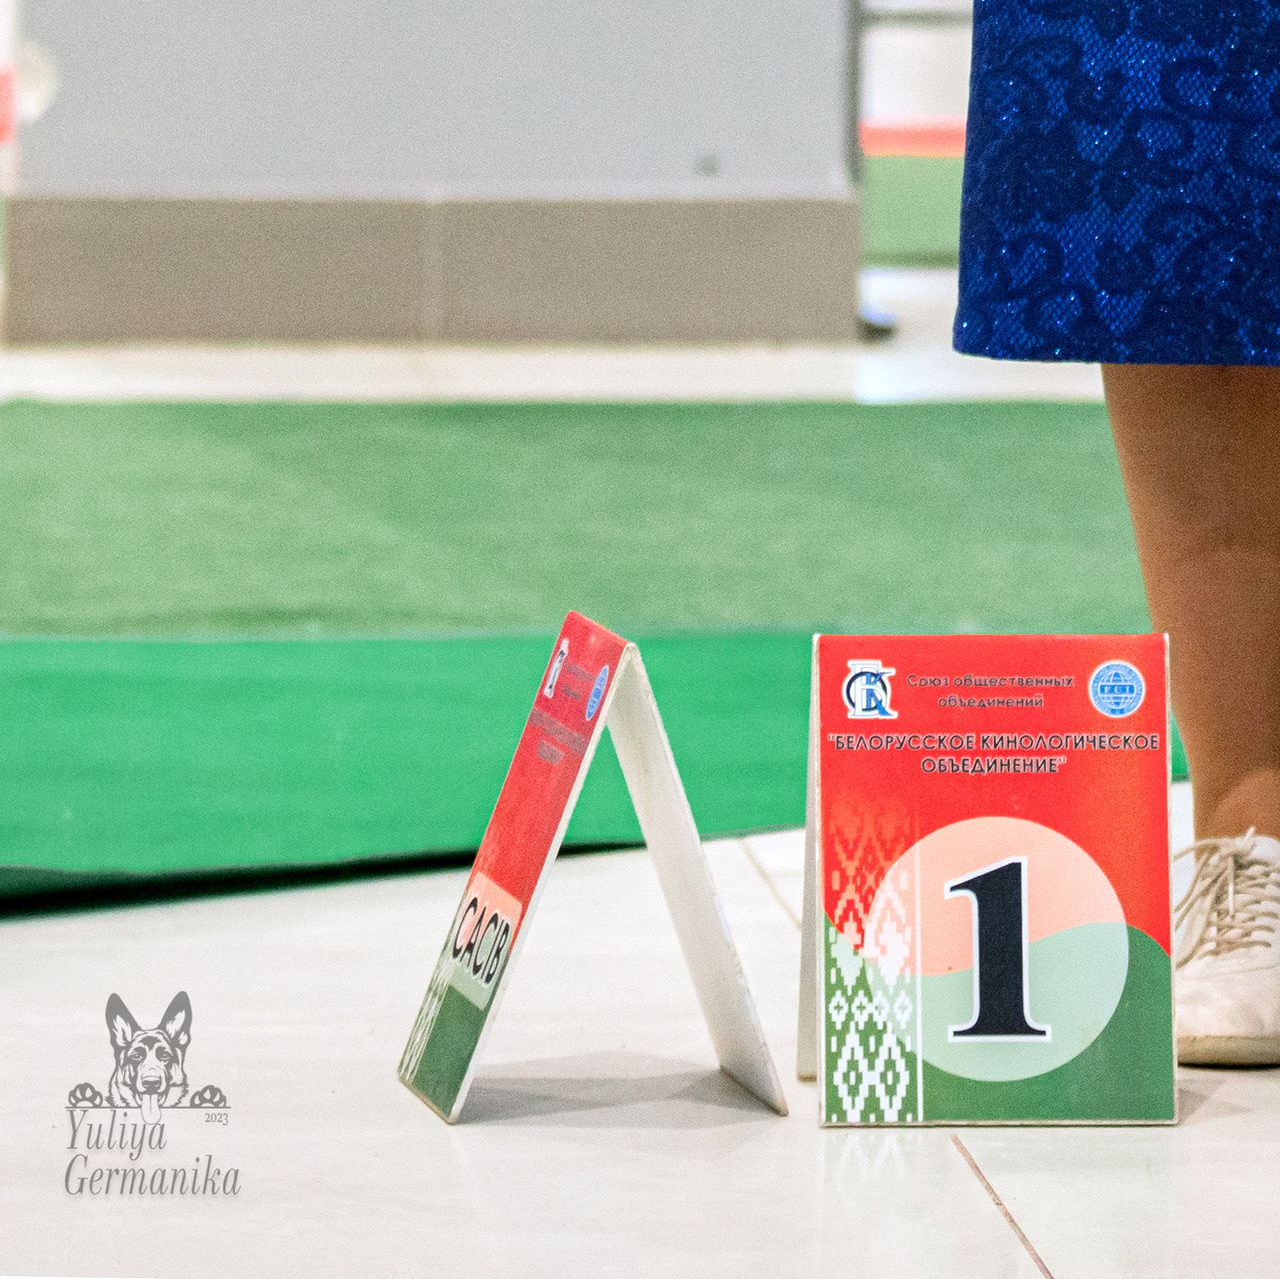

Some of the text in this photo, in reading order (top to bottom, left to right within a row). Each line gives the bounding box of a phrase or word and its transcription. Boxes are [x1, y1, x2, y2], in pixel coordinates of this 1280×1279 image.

[906, 673, 1074, 688] Союз общественных
[938, 694, 1044, 709] объединений
[981, 733, 1160, 751] КИНОЛОГИЧЕСКОЕ
[452, 896, 510, 985] CACIB
[946, 858, 1049, 1040] 1
